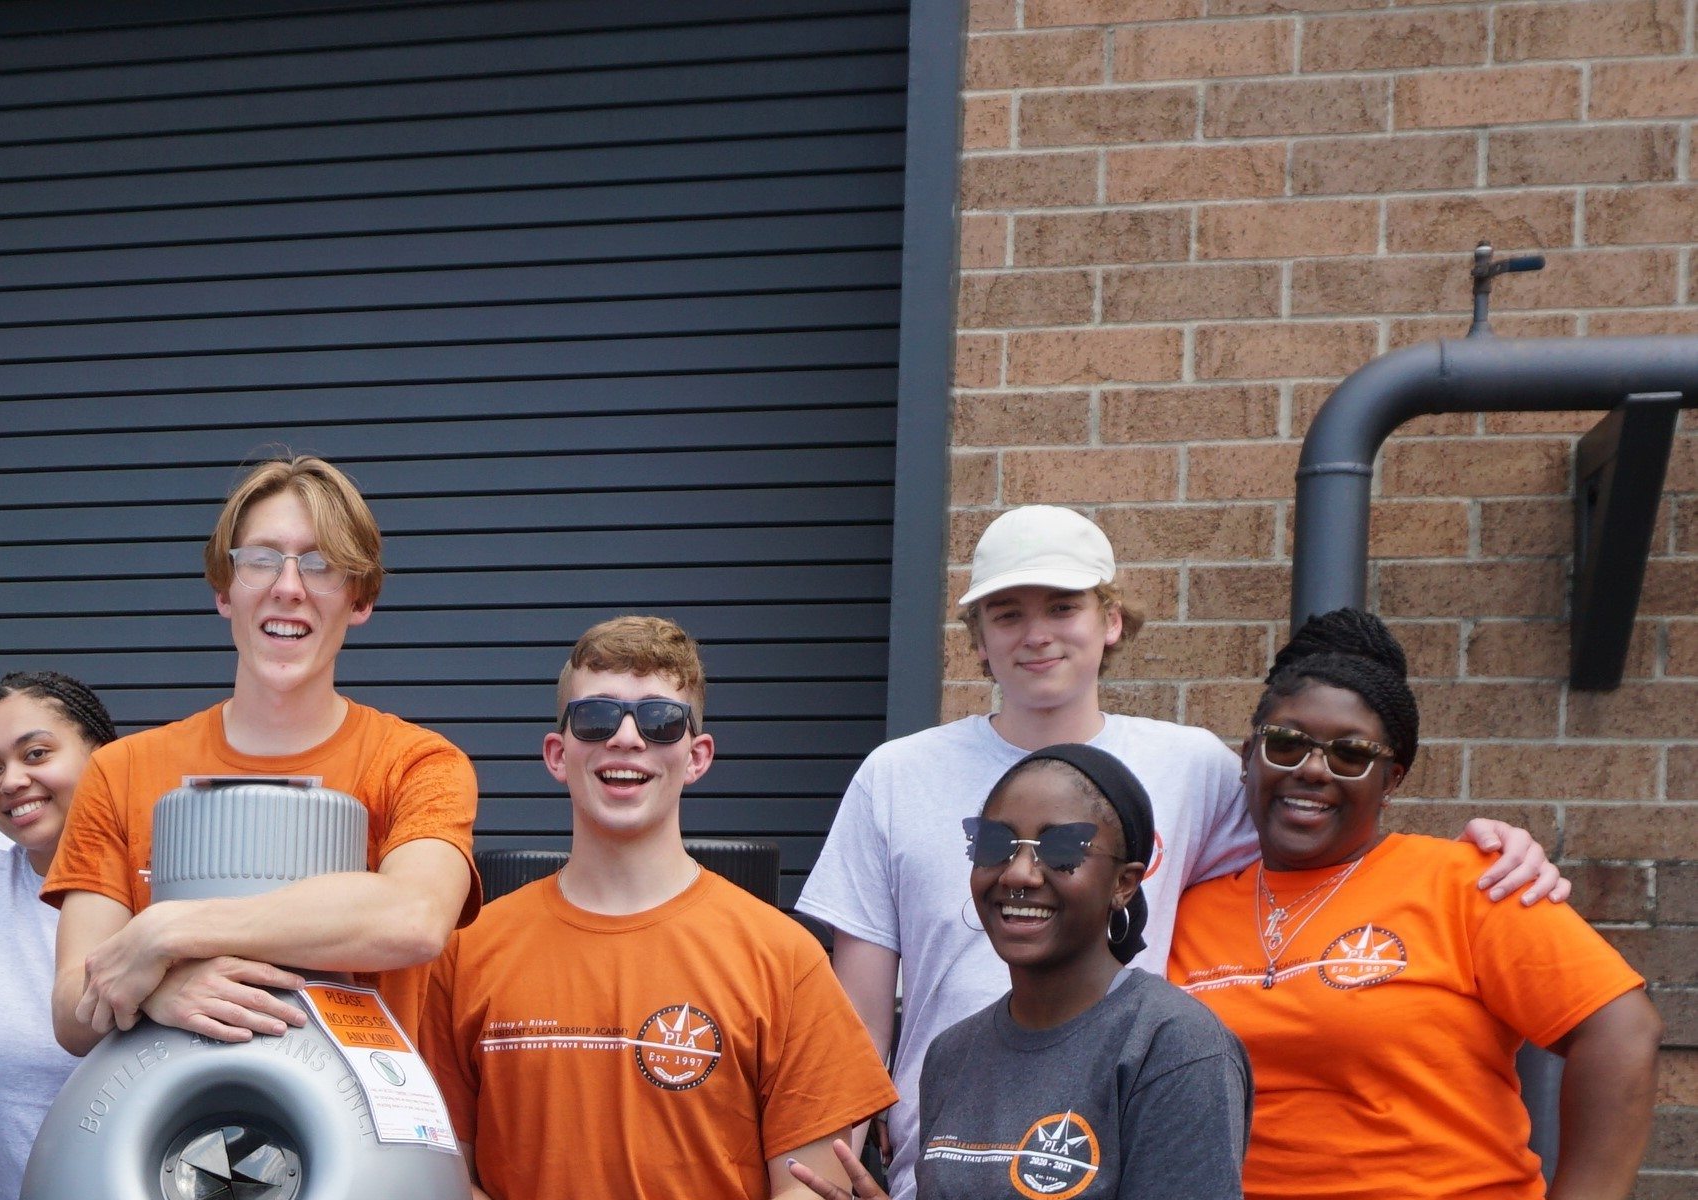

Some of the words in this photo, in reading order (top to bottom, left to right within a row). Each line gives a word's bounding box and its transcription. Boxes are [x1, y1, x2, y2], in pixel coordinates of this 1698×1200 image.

[1347, 949, 1380, 960] PLA
[324, 990, 366, 1007] PLEASE
[324, 1012, 343, 1025] NO
[343, 1014, 372, 1027] CUPS
[373, 1016, 388, 1028] OF
[347, 1031, 369, 1043] ANY
[370, 1032, 396, 1045] KIND
[483, 1027, 534, 1038] PRESIDENT'S
[536, 1026, 591, 1035] LEADERSHIP
[484, 1044, 519, 1052] BOWLING
[663, 1032, 697, 1049] PLA
[675, 1056, 703, 1067] 1997
[79, 1039, 170, 1136] BOTTLES
[260, 1030, 332, 1073] CANS
[1042, 1140, 1069, 1155] PLA
[1029, 1156, 1048, 1167] 2020
[1052, 1160, 1072, 1172] 2021
